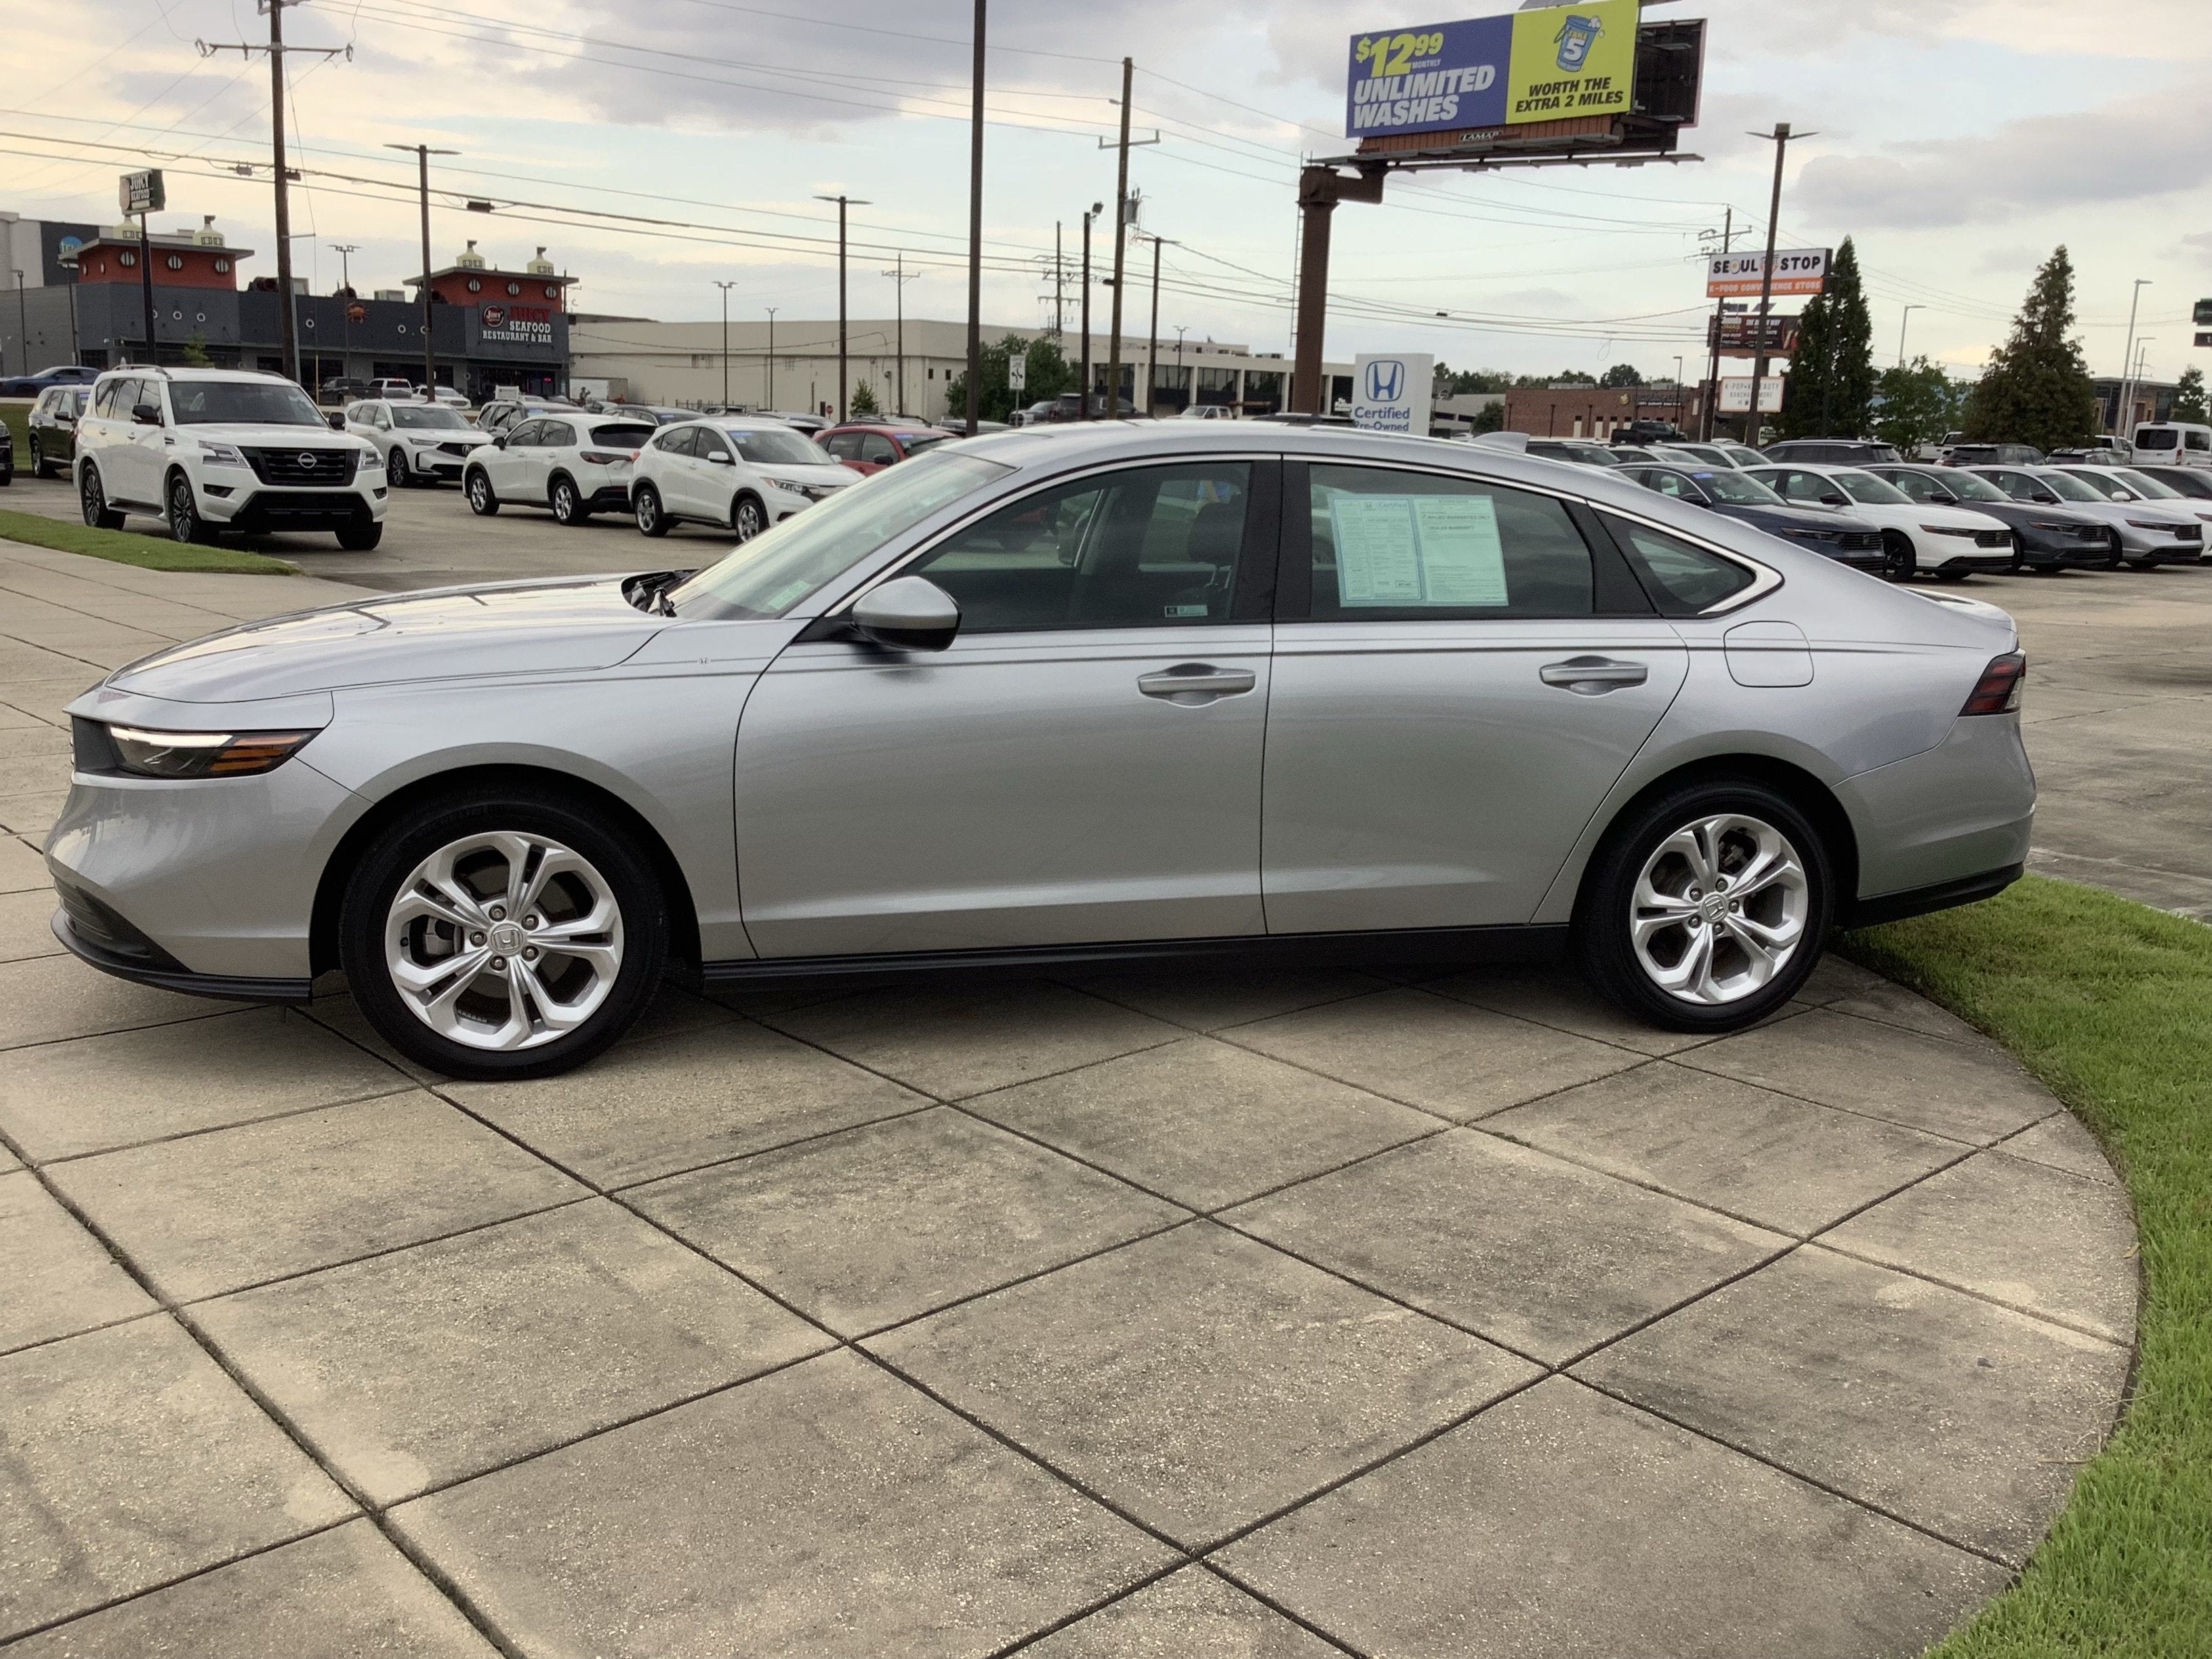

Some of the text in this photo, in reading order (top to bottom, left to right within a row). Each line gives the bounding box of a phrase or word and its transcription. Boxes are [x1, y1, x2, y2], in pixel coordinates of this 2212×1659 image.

[1563, 39, 1586, 62] 5
[1412, 58, 1441, 69] MONTHLY
[1354, 64, 1496, 104] UNLIMITED
[1529, 77, 1612, 97] WORTH THE
[1515, 91, 1624, 112] EXTRA 2 MILES
[1353, 94, 1460, 129] WASHES
[130, 173, 149, 190] JUICY
[1713, 256, 1821, 274] SEOUL STOP
[510, 321, 551, 333] SEAFOOD
[483, 330, 552, 344] RESTAURANT & BAR
[1354, 407, 1410, 419] Certified
[1355, 421, 1410, 432] Pre-Owned
